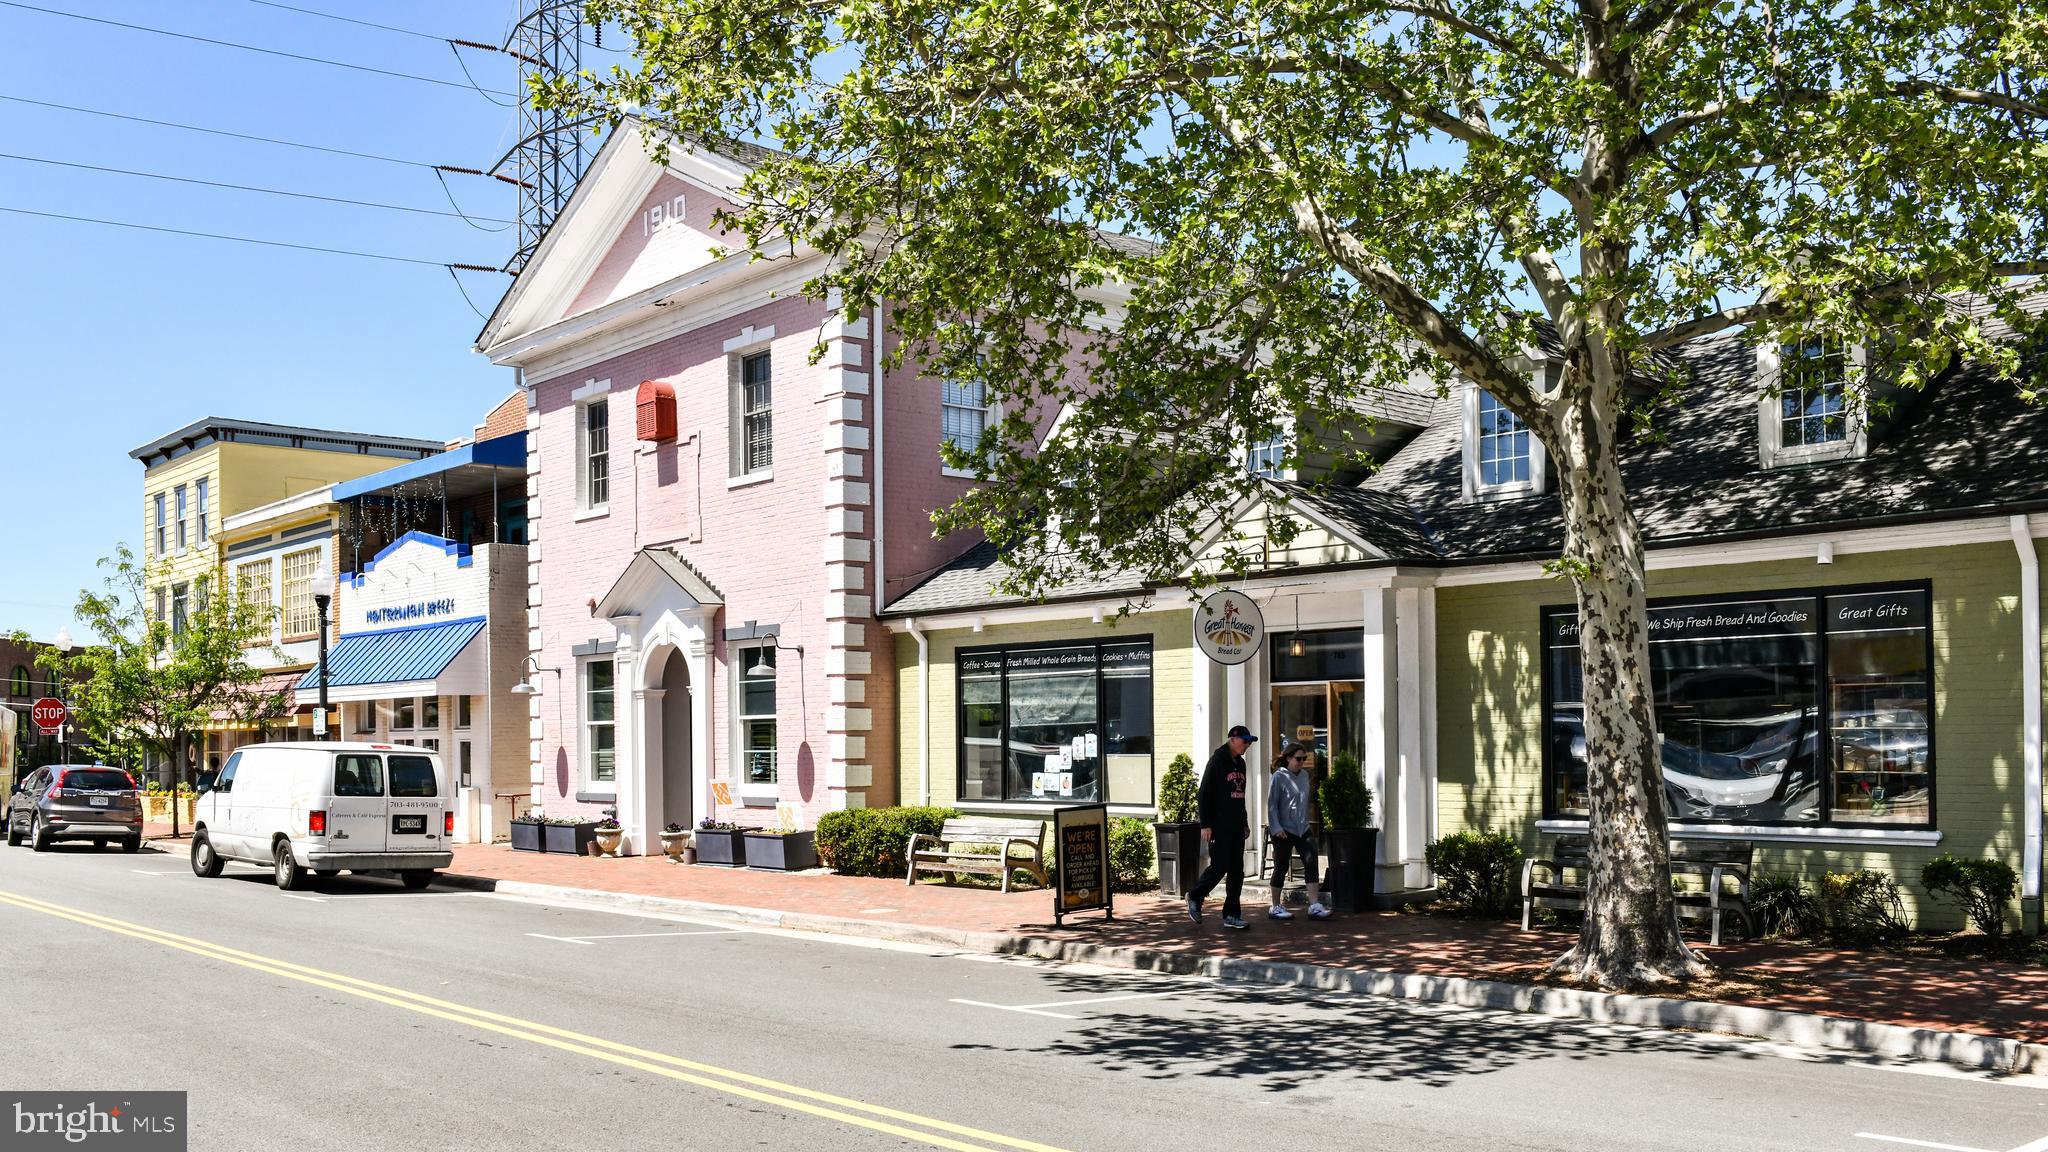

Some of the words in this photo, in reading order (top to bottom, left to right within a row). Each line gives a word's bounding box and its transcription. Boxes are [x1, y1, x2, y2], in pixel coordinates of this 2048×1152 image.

[643, 194, 686, 237] 1910
[1838, 607, 1873, 619] Great
[1876, 603, 1909, 617] Gifts
[1647, 619, 1661, 630] We
[1662, 616, 1684, 630] Ship
[1686, 616, 1713, 628] Fresh
[1715, 613, 1744, 626] Bread
[1746, 611, 1768, 624] And
[1768, 610, 1808, 623] Goodies
[1204, 616, 1226, 634] Great
[1230, 617, 1255, 637] Harvest
[1102, 653, 1124, 661] Cookies
[1128, 650, 1151, 660] Muffins
[1217, 646, 1233, 655] Bread
[962, 660, 980, 669] Coffee
[983, 660, 1001, 669] Scones
[1006, 658, 1022, 667] Fresh
[1022, 657, 1041, 666] Milled
[1041, 655, 1059, 664] Whole
[1060, 654, 1077, 664] Grain
[1077, 653, 1097, 663] Breads
[34, 707, 64, 719] STOP
[1298, 729, 1314, 737] OPEN
[1067, 830, 1096, 842] WE'RE
[1066, 861, 1082, 869] ORDER
